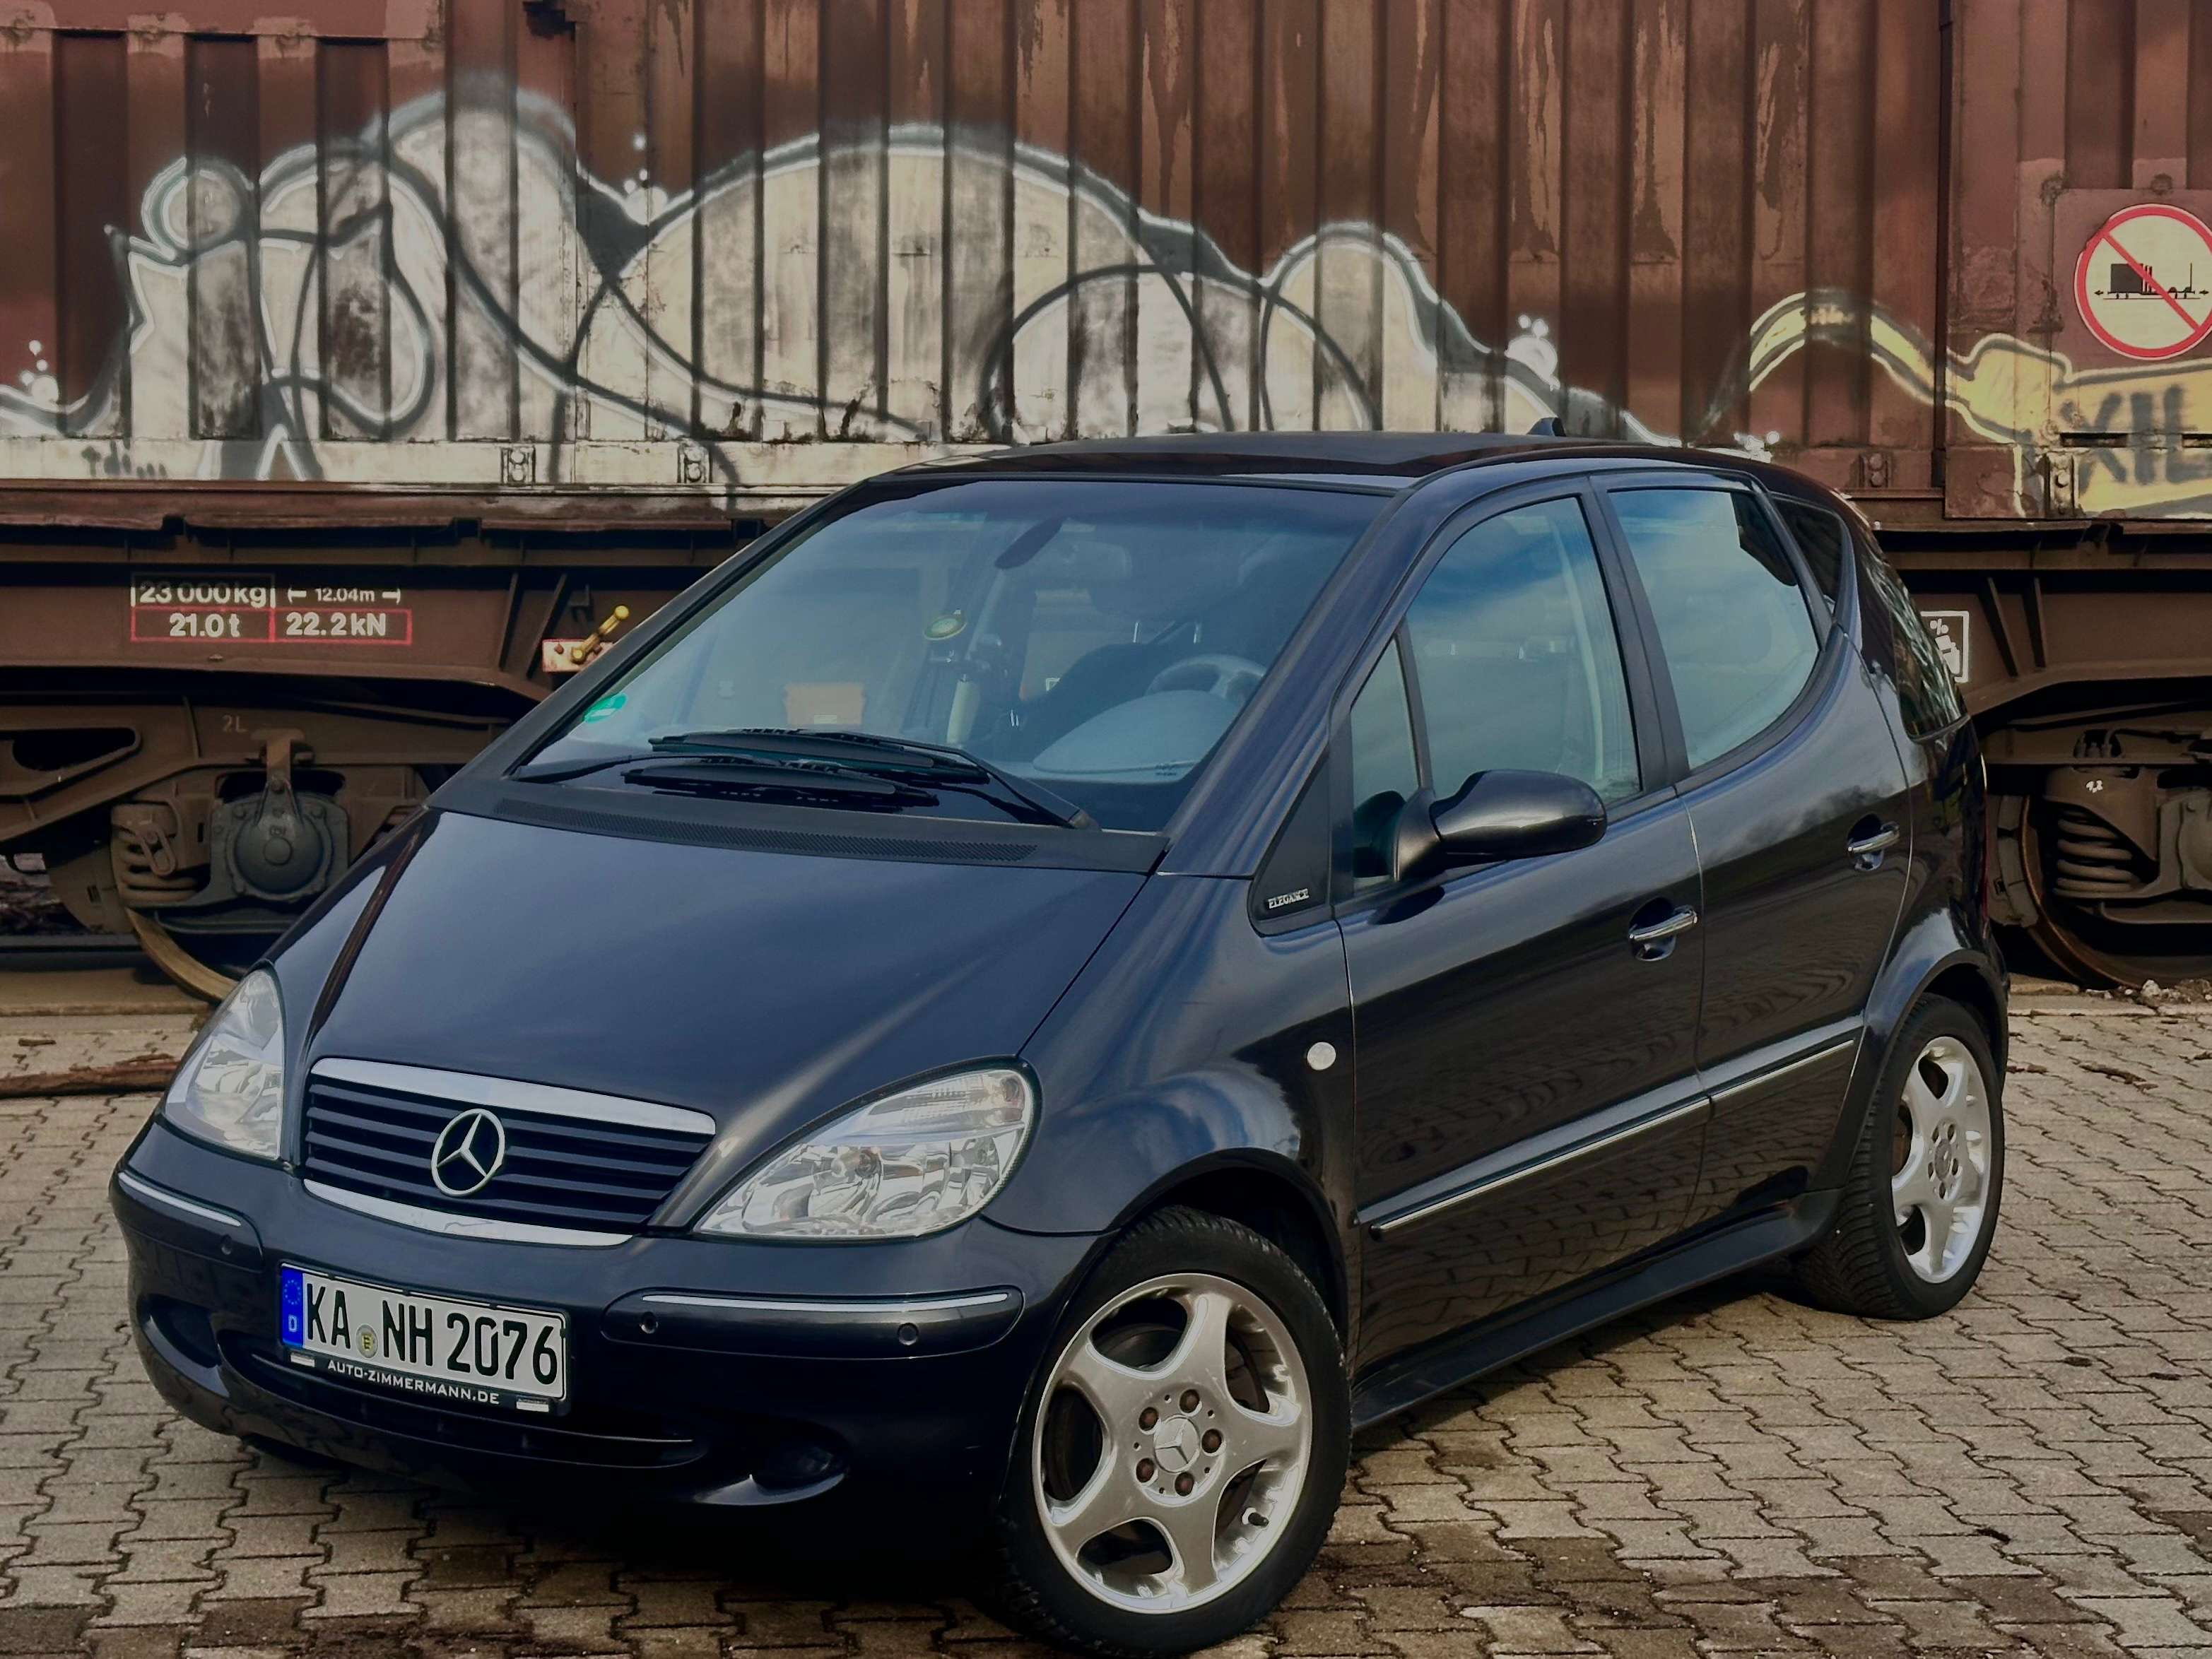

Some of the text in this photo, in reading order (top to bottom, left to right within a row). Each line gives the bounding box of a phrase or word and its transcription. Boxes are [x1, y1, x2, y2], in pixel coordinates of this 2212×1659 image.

[139, 581, 172, 603] 23
[169, 613, 224, 637] 21.0
[1268, 888, 1310, 909] ELEGANCE
[288, 1315, 298, 1332] D
[307, 1283, 558, 1385] KA NH 2076
[327, 1359, 500, 1405] AUTO-ZIMMERMANN.DE
